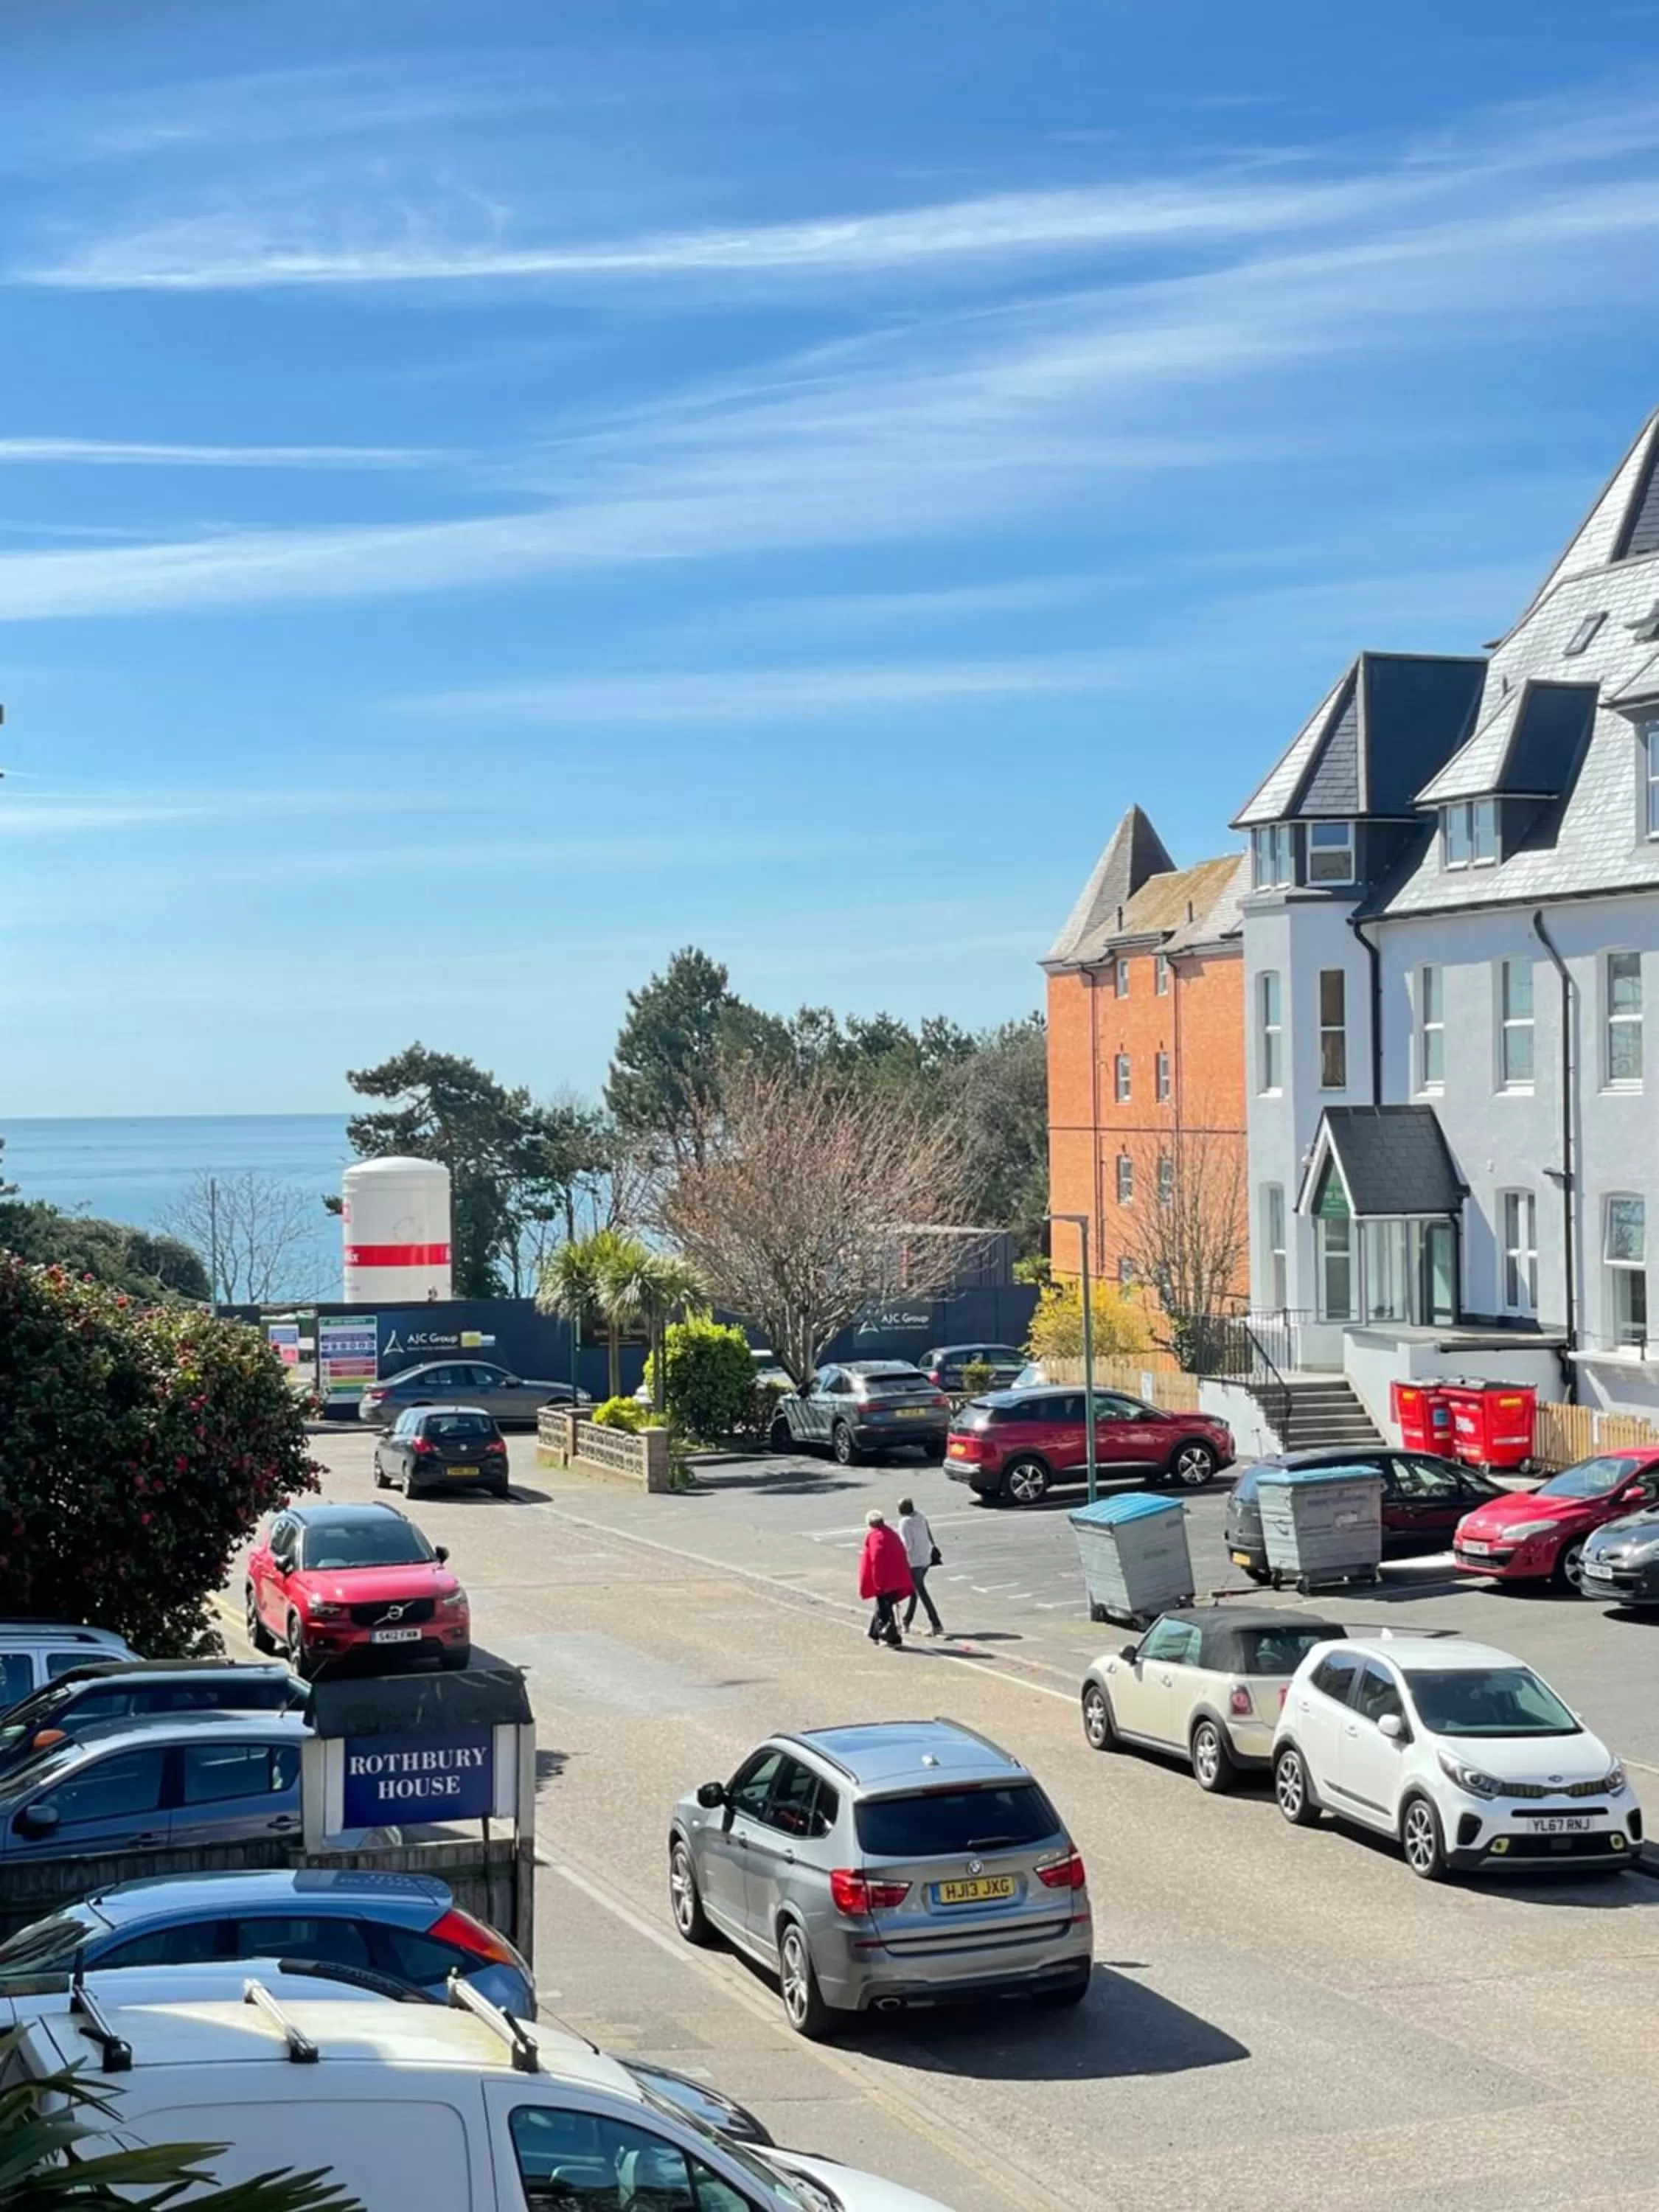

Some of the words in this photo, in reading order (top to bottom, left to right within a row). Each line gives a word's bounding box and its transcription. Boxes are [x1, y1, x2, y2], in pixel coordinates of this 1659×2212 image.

[881, 1312, 900, 1324] AJC
[407, 1332, 428, 1344] AJC
[429, 1332, 459, 1344] Group
[349, 1746, 487, 1775] ROTHBURY
[378, 1775, 461, 1800] HOUSE
[946, 1880, 978, 1900] HJ13
[983, 1877, 1010, 1896] JXG
